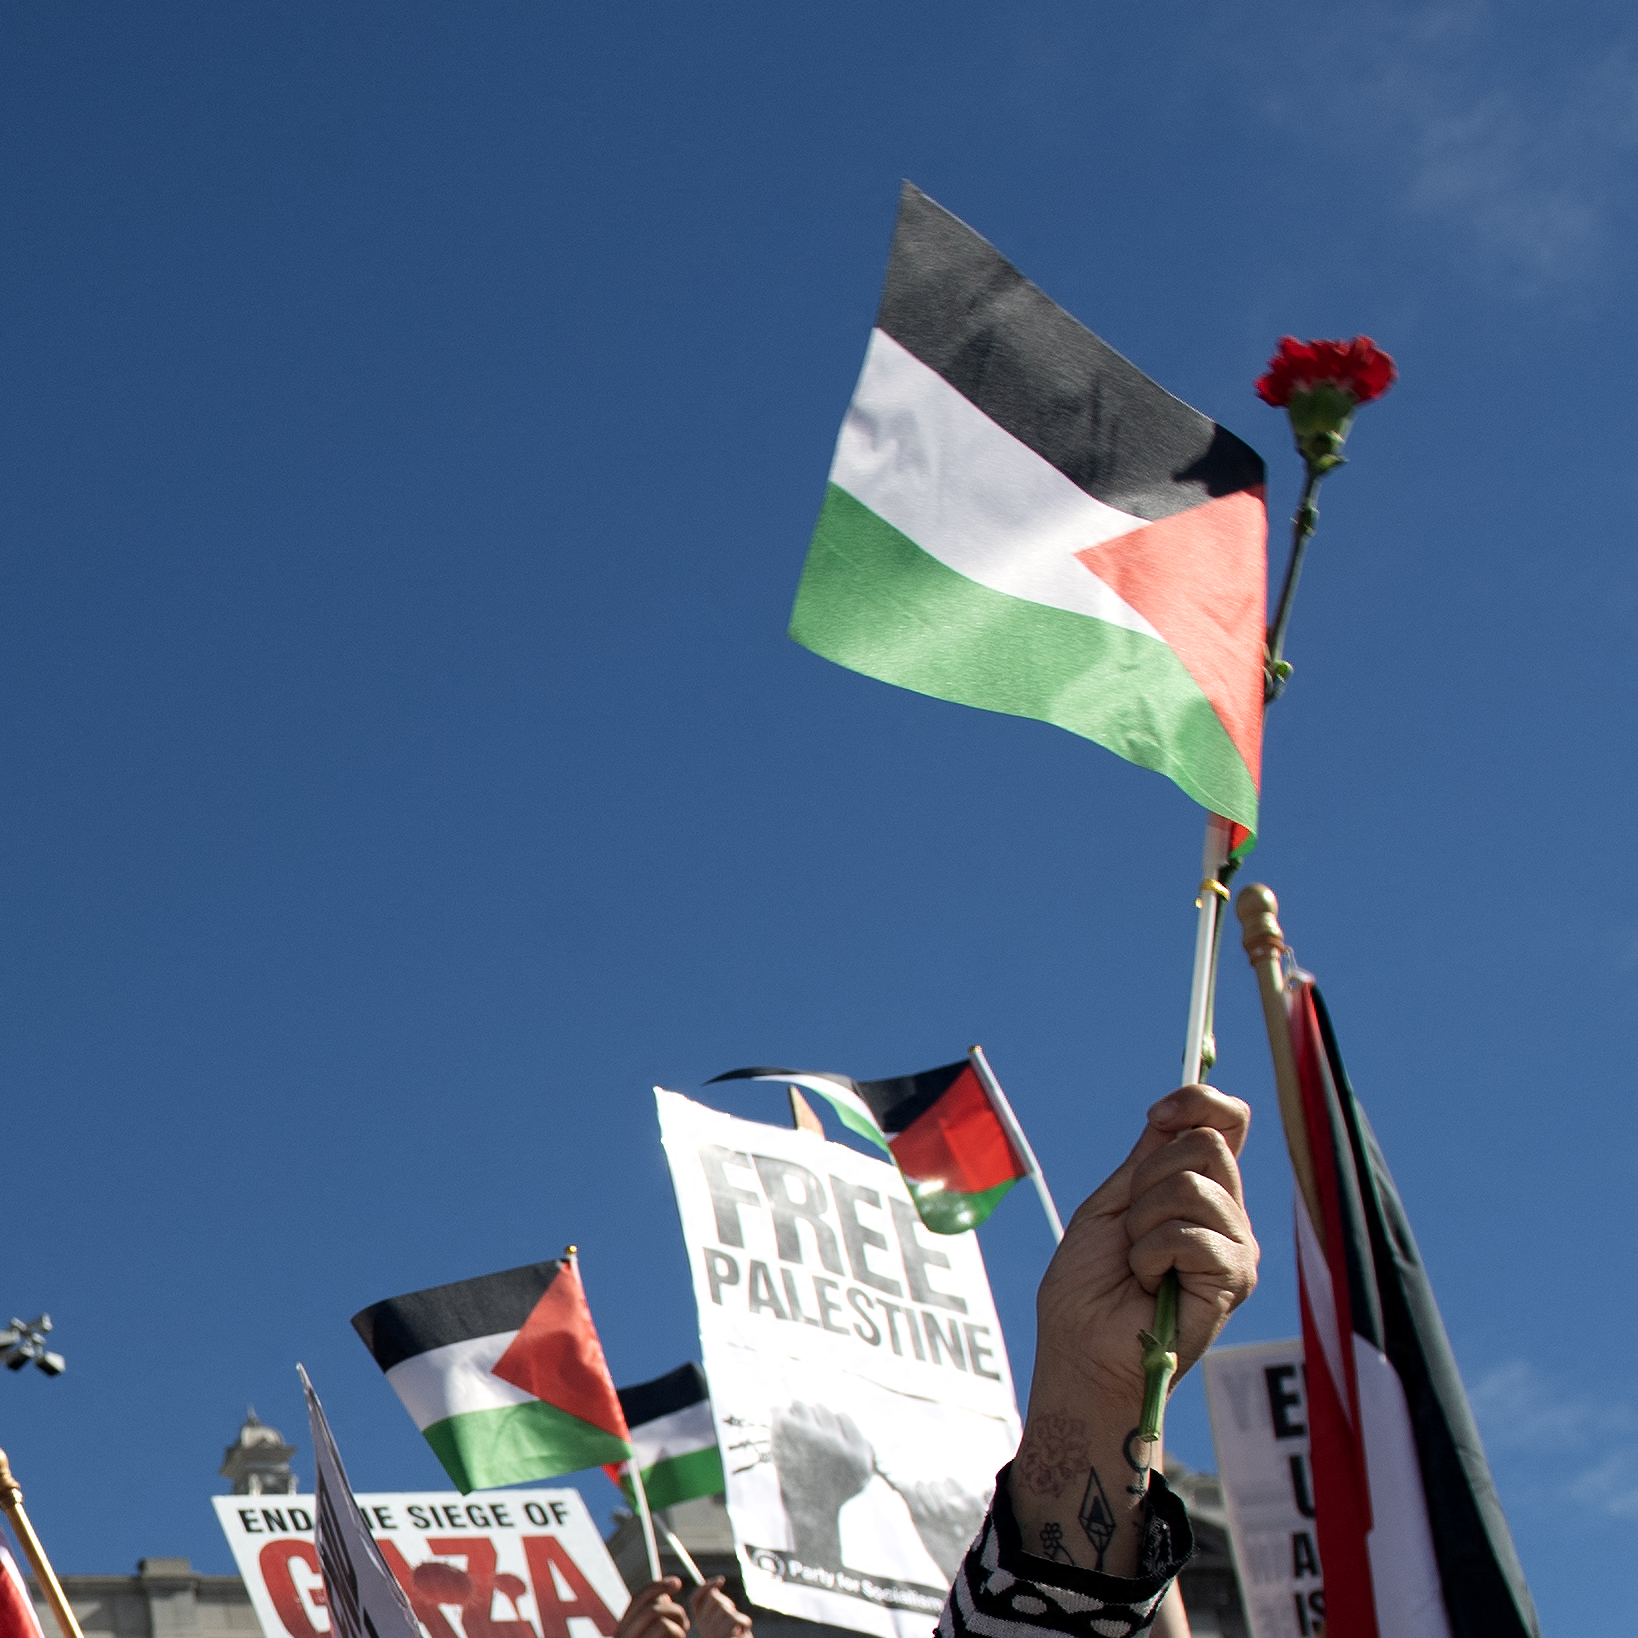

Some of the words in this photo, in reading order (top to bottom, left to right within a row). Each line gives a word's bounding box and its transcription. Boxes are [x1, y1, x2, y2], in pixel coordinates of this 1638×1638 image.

[699, 1144, 968, 1315] FREE
[702, 1247, 1002, 1381] PALESTINE
[238, 1507, 314, 1533] END
[407, 1503, 514, 1530] SIEGE
[524, 1500, 570, 1527] OF
[788, 1558, 835, 1588] Party
[836, 1571, 861, 1593] for
